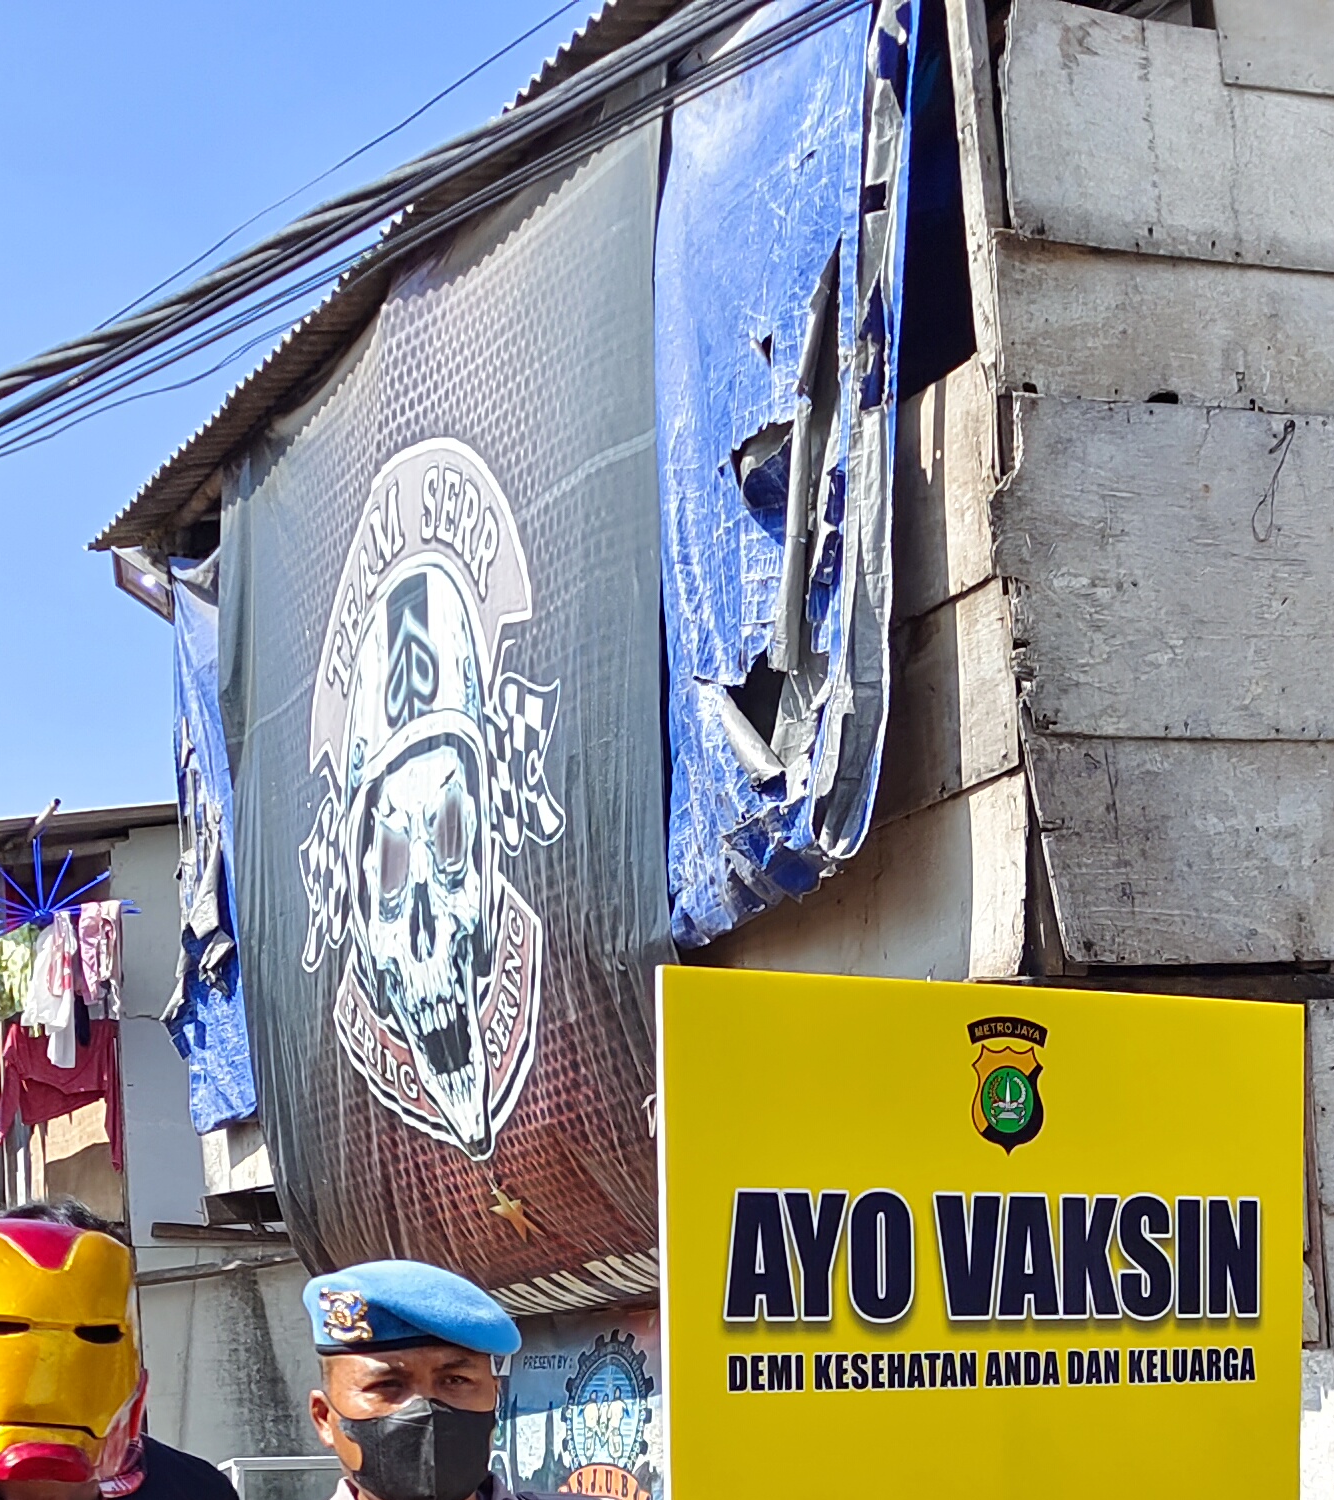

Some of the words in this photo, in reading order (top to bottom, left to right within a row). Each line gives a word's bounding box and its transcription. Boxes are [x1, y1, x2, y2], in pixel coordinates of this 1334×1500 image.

[327, 480, 405, 697] TEAM
[420, 463, 499, 602] SERR
[344, 993, 420, 1100] SERING
[483, 908, 524, 1069] SERING
[974, 1022, 1013, 1037] METRO
[1014, 1024, 1040, 1040] JAYA
[723, 1188, 915, 1323] AYO
[933, 1192, 1260, 1321] VAKSIN
[728, 1354, 804, 1392] DEMI
[814, 1352, 977, 1390] KESEHATAN
[985, 1351, 1060, 1388] ANDA
[1068, 1349, 1120, 1385] DAN
[1128, 1347, 1256, 1384] KELUARGA
